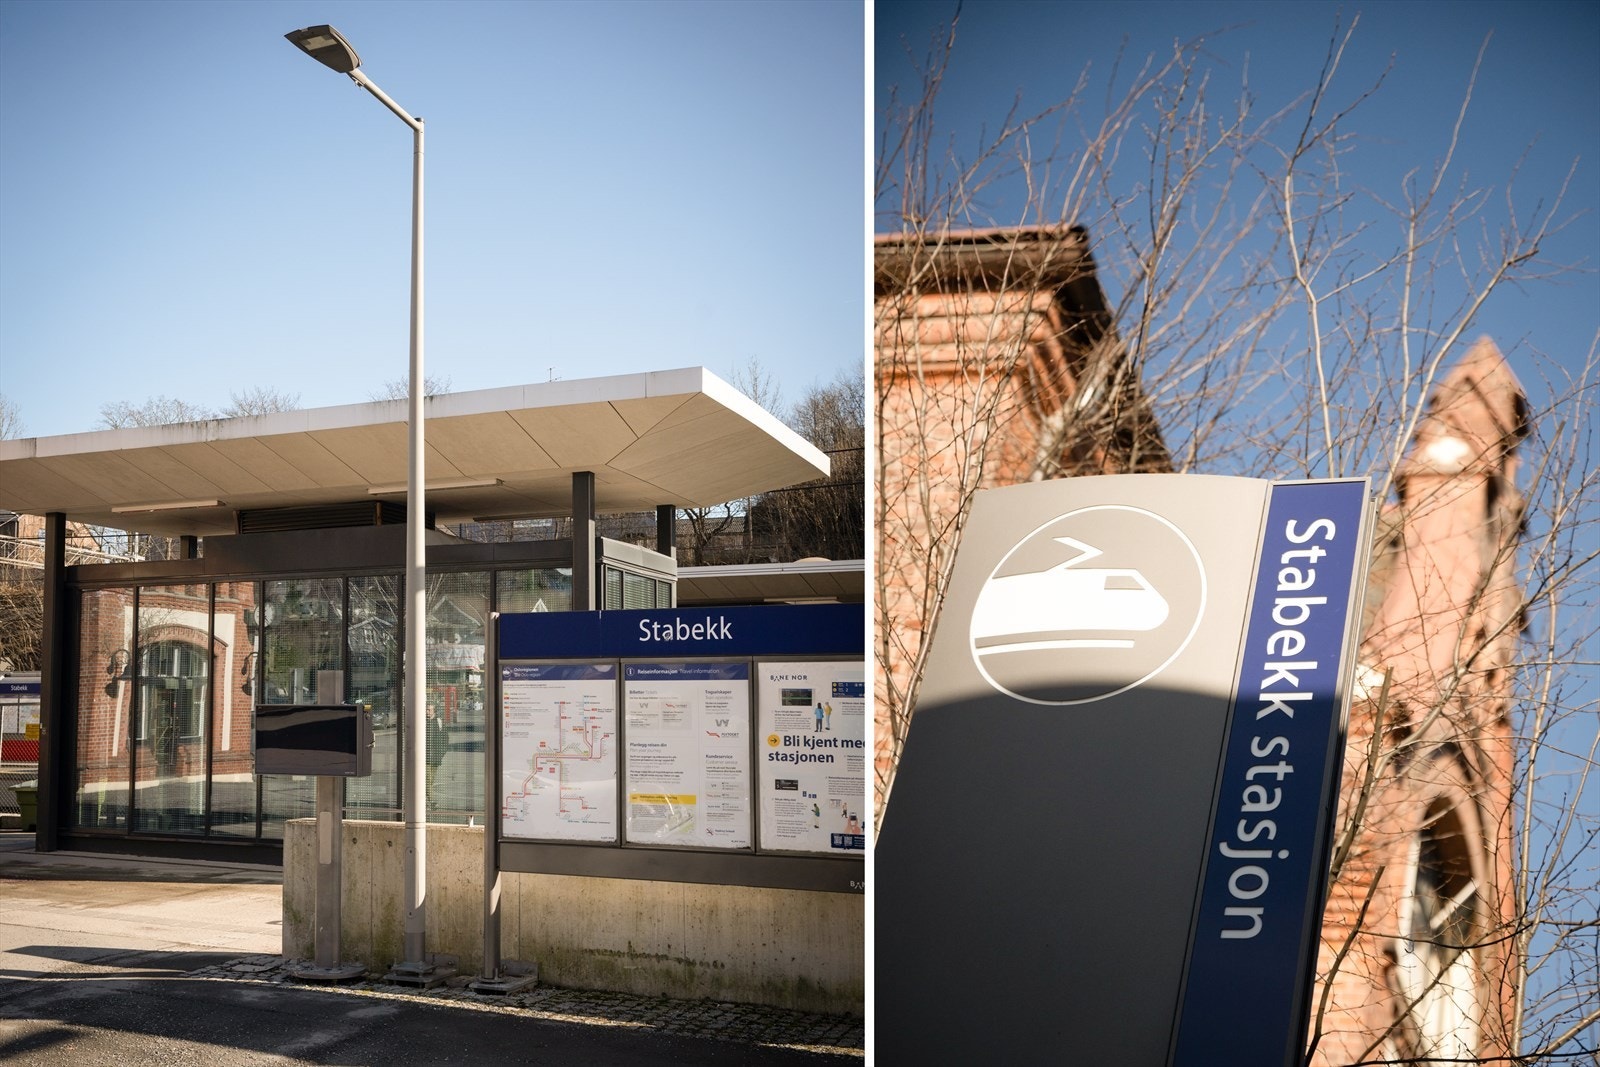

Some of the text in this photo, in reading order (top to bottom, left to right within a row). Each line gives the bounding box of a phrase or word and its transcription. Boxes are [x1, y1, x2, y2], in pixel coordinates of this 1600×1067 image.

[639, 616, 733, 642] Stabekk
[769, 674, 789, 682] BANE
[1219, 518, 1336, 939] Stabekk stasjon
[783, 735, 800, 748] Bli
[803, 735, 838, 750] kjent
[768, 751, 834, 765] stasjonen
